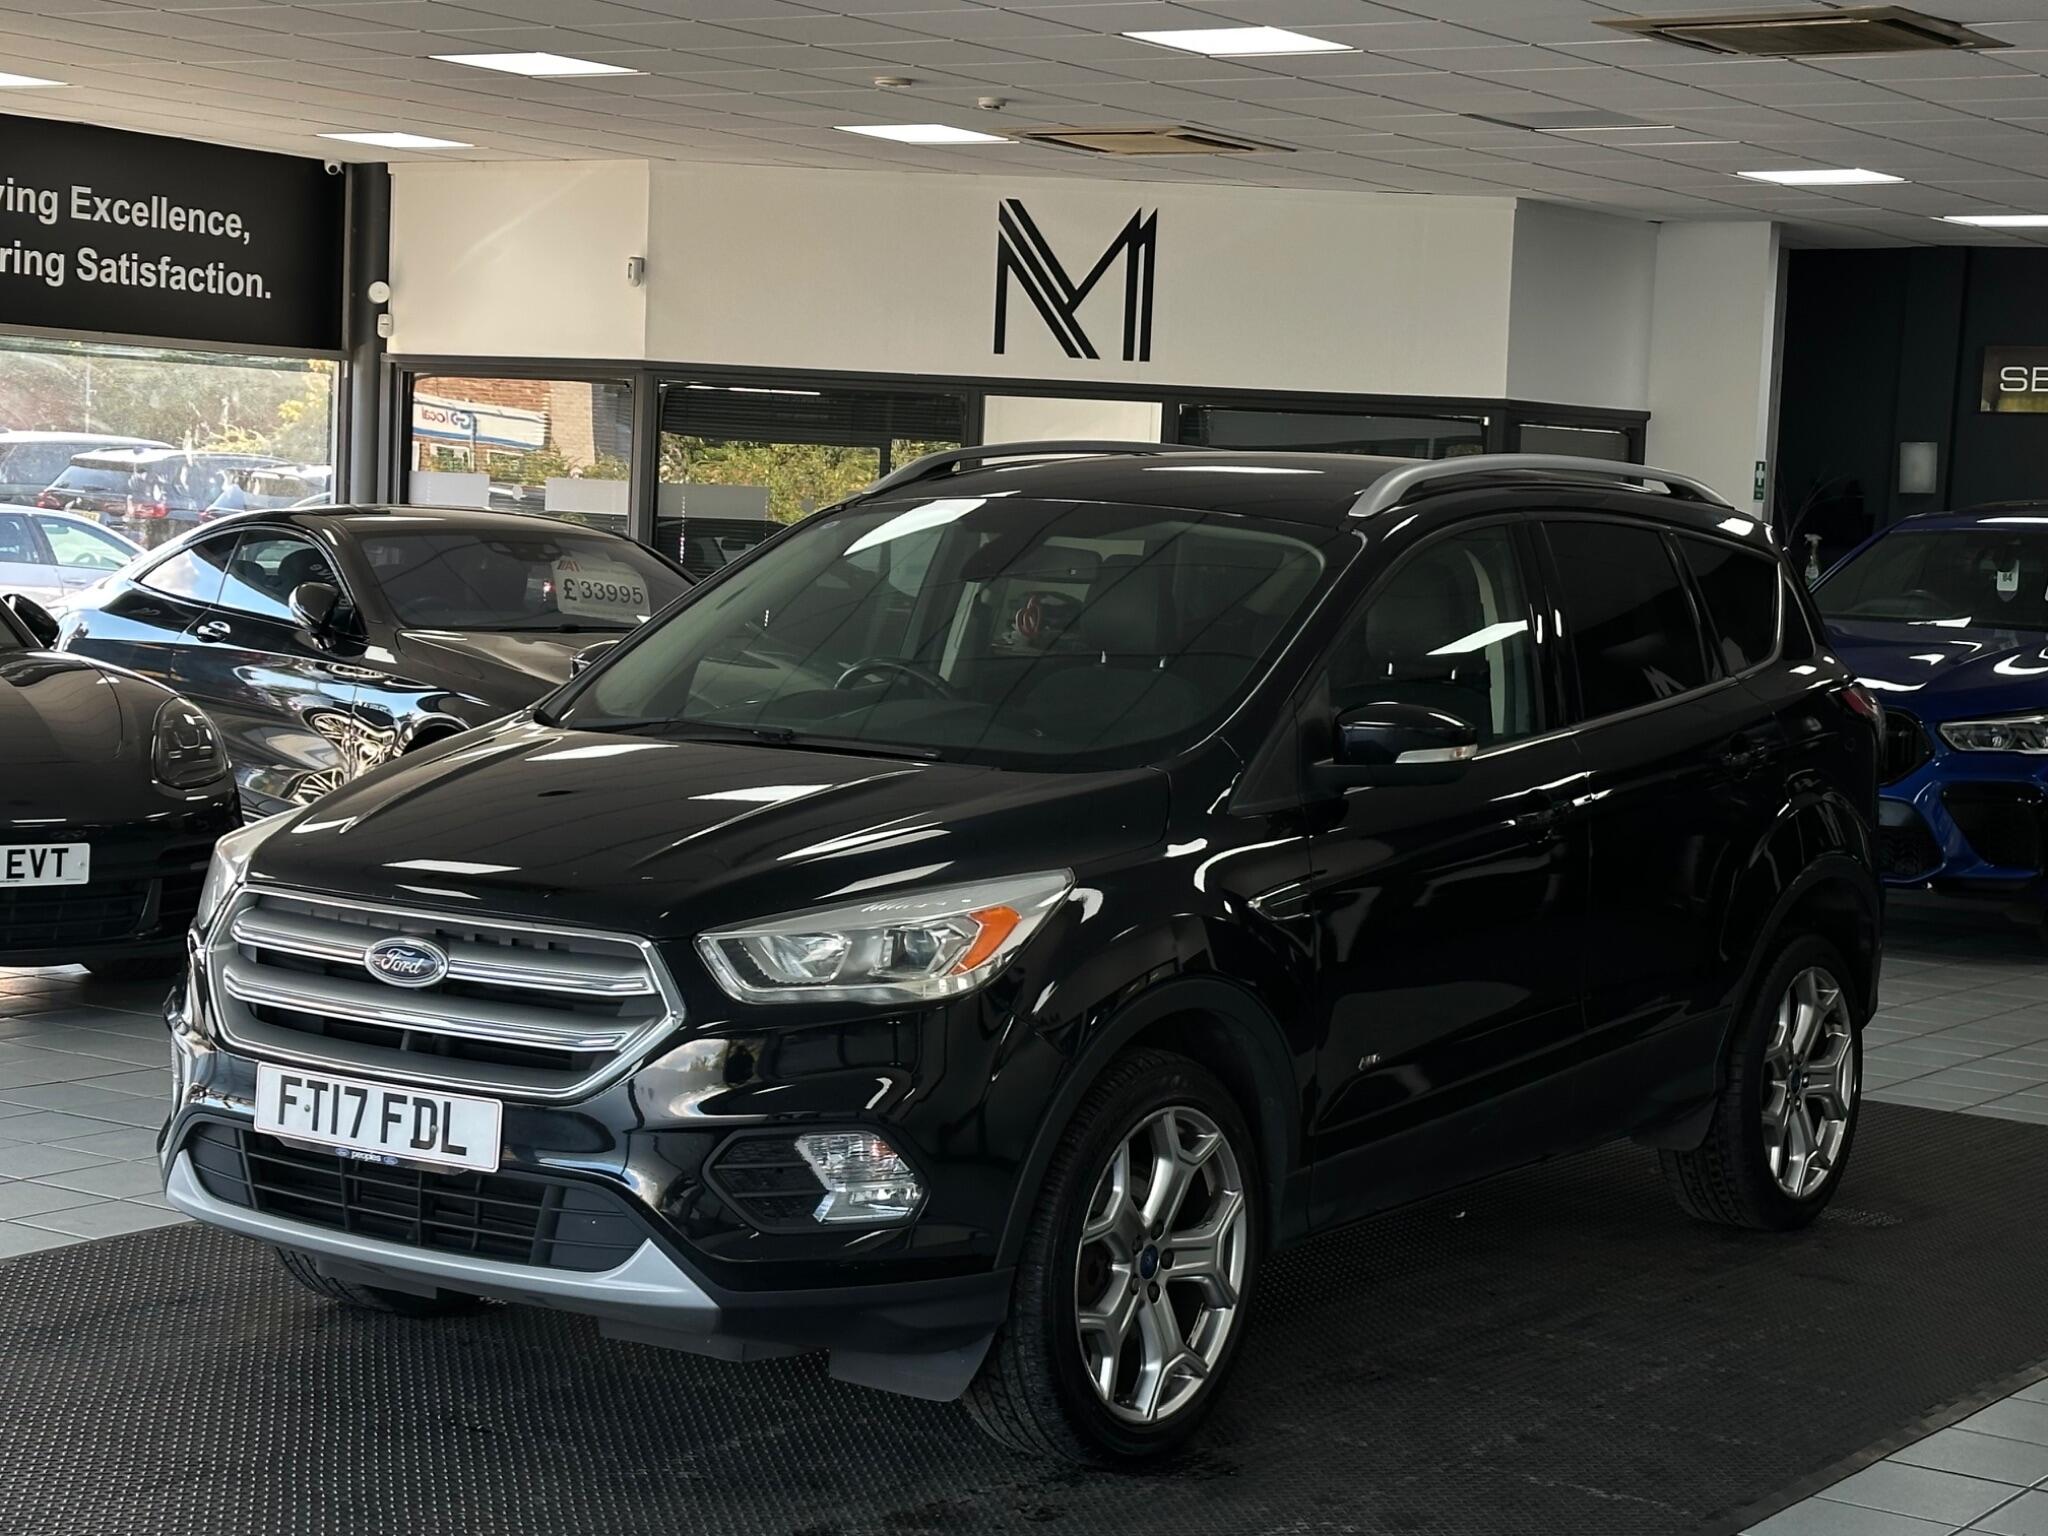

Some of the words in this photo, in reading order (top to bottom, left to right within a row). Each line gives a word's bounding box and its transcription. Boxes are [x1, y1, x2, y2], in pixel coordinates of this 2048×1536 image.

[70, 185, 250, 245] Excellence,
[76, 246, 272, 299] Satisfaction.
[563, 578, 644, 605] £33995
[6, 847, 69, 879] EVT
[381, 948, 425, 974] Ford
[278, 1074, 368, 1139] FT17
[380, 1092, 467, 1156] FDL
